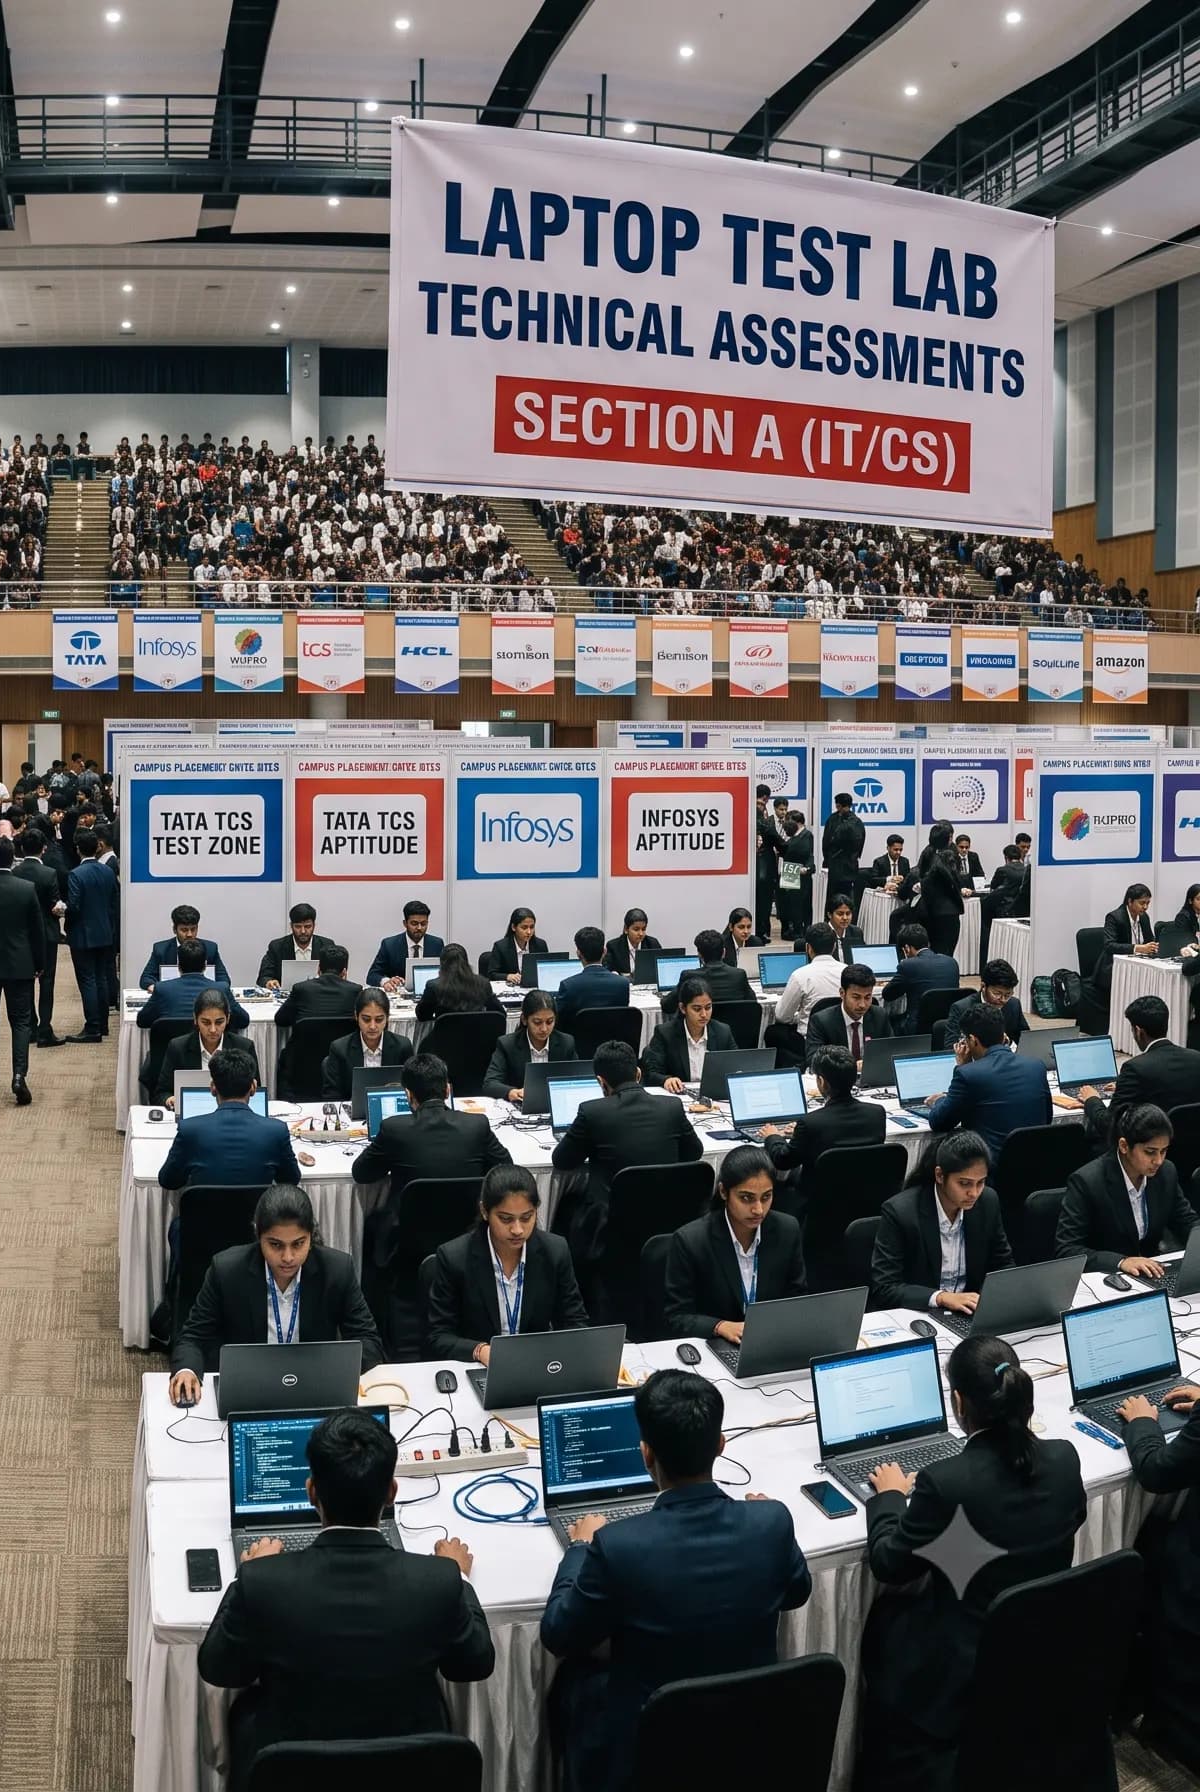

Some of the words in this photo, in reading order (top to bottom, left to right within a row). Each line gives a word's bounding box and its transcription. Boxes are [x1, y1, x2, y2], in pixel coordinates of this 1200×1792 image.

[444, 181, 701, 278] LAPTOP
[722, 213, 871, 300] TEST
[892, 240, 999, 320] LAB
[418, 281, 694, 358] TECHNICAL
[709, 310, 1025, 399] ASSESSMENTS
[513, 391, 734, 457] SECTION
[752, 414, 785, 462] A
[801, 417, 957, 486] (IT/CS)
[138, 637, 197, 659] Infosys
[401, 646, 453, 656] HCL
[65, 654, 107, 666] TATA
[1096, 656, 1145, 668] amazon
[134, 762, 172, 772] CAMPUS
[298, 762, 335, 772] CAMPUS
[460, 762, 496, 771] CAMPUS
[614, 761, 648, 771] CAMPUS
[942, 789, 972, 800] wipro
[850, 802, 888, 814] TATA
[160, 811, 209, 831] TATA
[214, 811, 253, 831] TCS
[322, 811, 372, 831] TATA
[377, 811, 416, 831] TCS
[641, 808, 720, 828] INFOSYS
[481, 810, 575, 848] Infosys
[152, 836, 203, 855] TEST
[208, 836, 261, 855] ZONE
[320, 836, 419, 855] APTITUDE
[635, 832, 725, 851] APTITUDE
